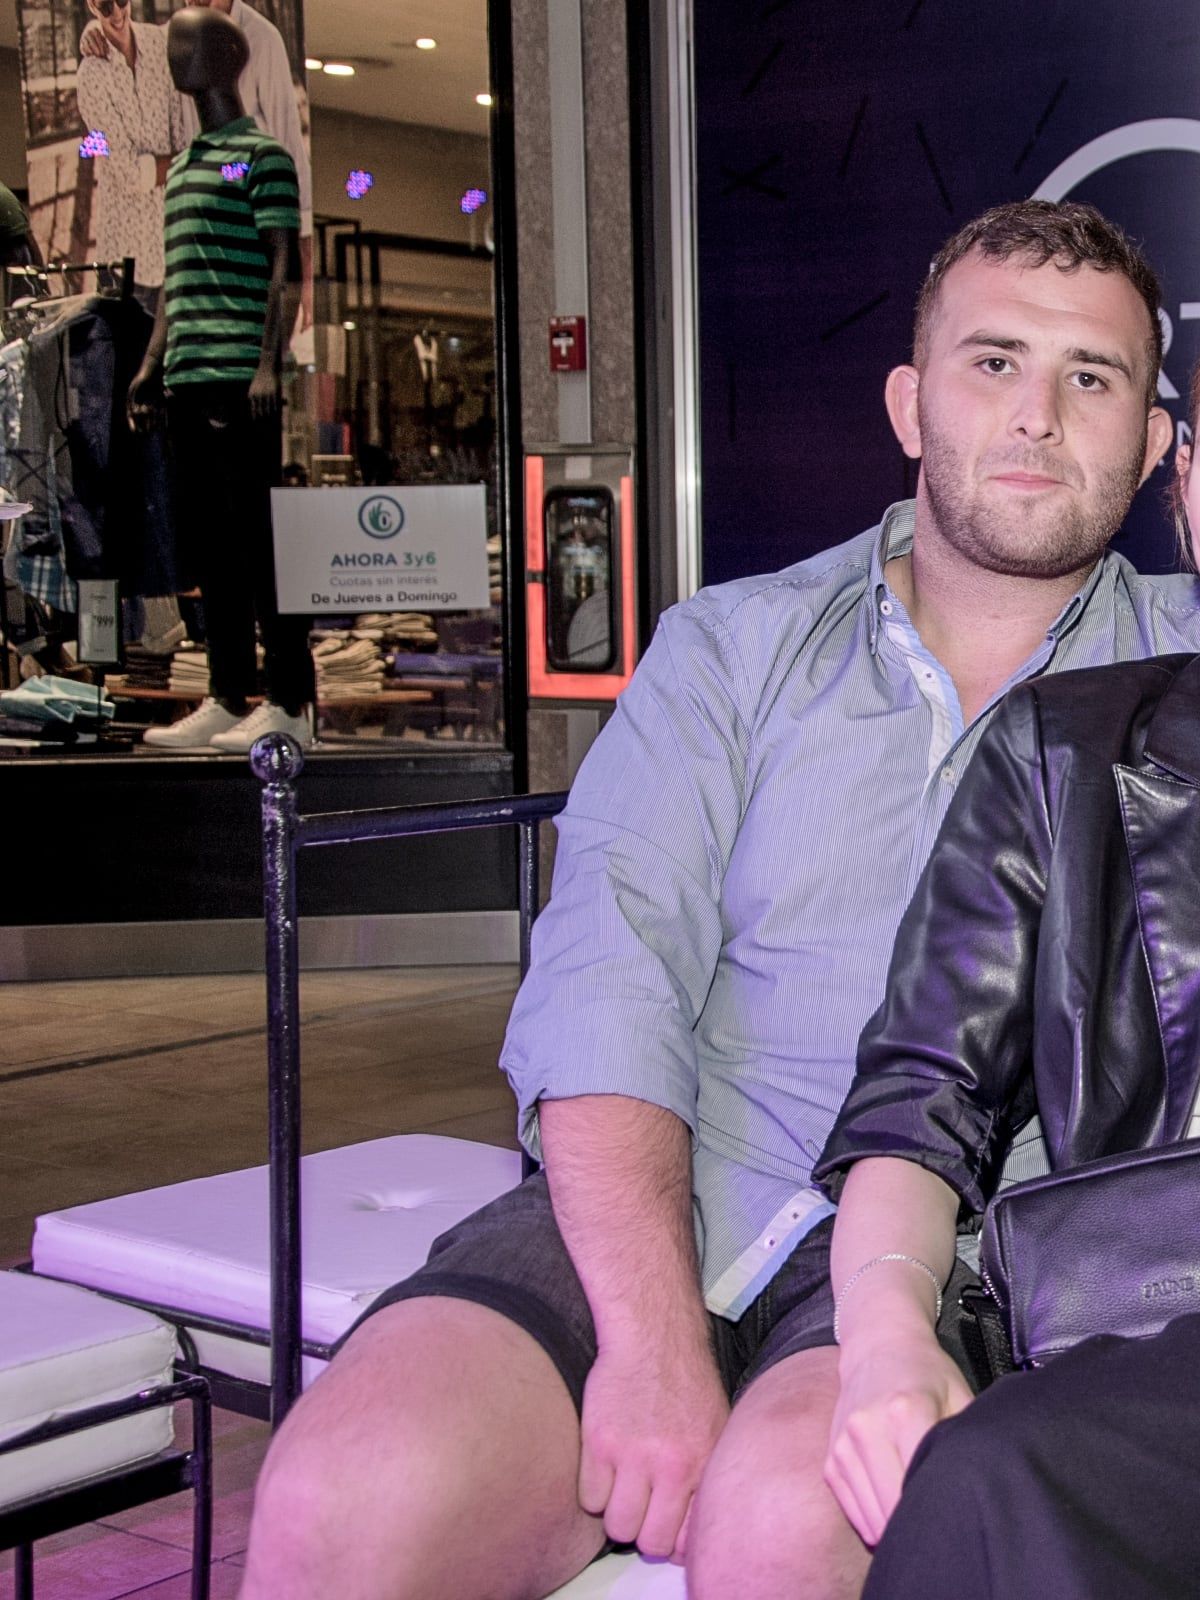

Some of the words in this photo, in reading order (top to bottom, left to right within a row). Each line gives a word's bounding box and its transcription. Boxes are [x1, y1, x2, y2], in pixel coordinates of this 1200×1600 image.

[330, 553, 398, 567] AHORA
[329, 575, 373, 587] Cuotas
[376, 573, 393, 585] sin
[397, 572, 438, 585] interés
[311, 592, 330, 604] De
[334, 591, 382, 604] Jueves
[386, 593, 394, 602] a
[398, 590, 457, 604] Domingo
